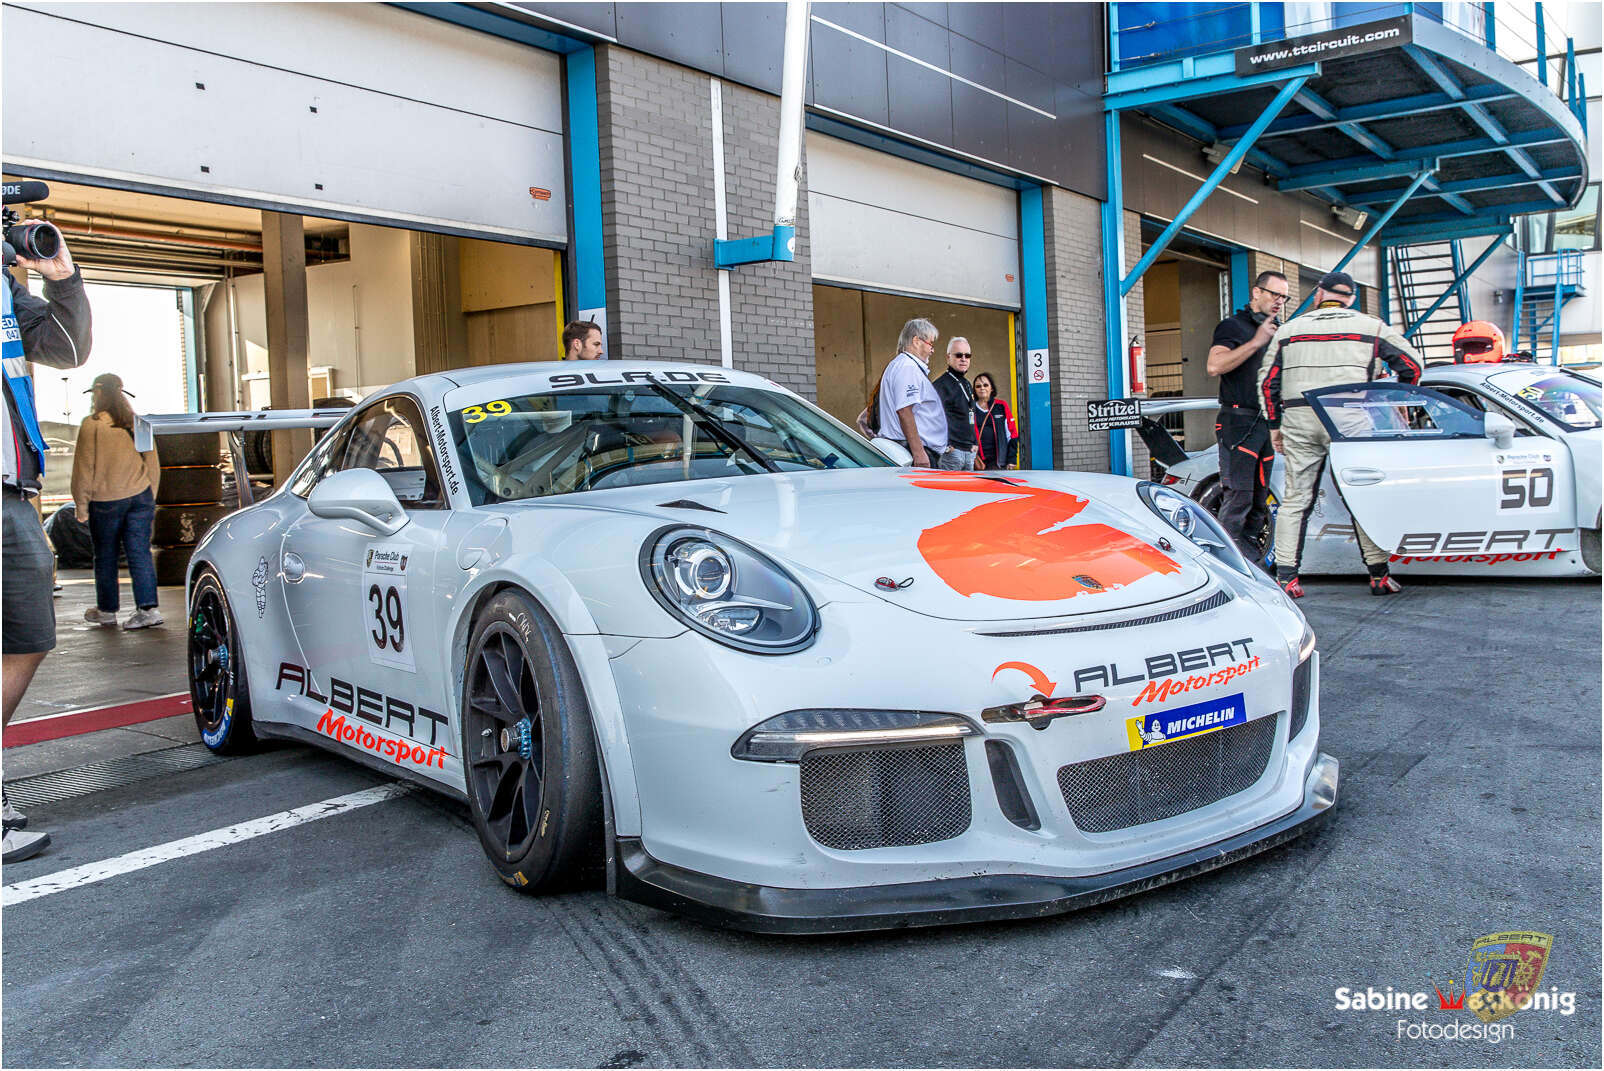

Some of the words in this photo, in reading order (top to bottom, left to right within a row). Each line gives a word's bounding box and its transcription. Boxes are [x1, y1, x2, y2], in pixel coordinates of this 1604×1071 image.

[1249, 27, 1400, 65] www.ttcircuit.com
[1034, 352, 1043, 368] 3
[462, 400, 512, 424] 39
[1088, 400, 1140, 418] Stritzel
[1480, 382, 1545, 423] Albert-Motorsport.de
[1517, 386, 1545, 401] 50
[1089, 423, 1110, 431] KLZ
[430, 405, 460, 496] Albert-Motorsport.de
[1501, 467, 1554, 509] 50
[368, 583, 405, 653] 39
[1073, 637, 1254, 693] ALBERT
[1131, 655, 1260, 707] Motorsport
[275, 661, 449, 746] ALBERT
[1166, 706, 1236, 735] MICHELIN
[316, 708, 450, 770] Motorsport
